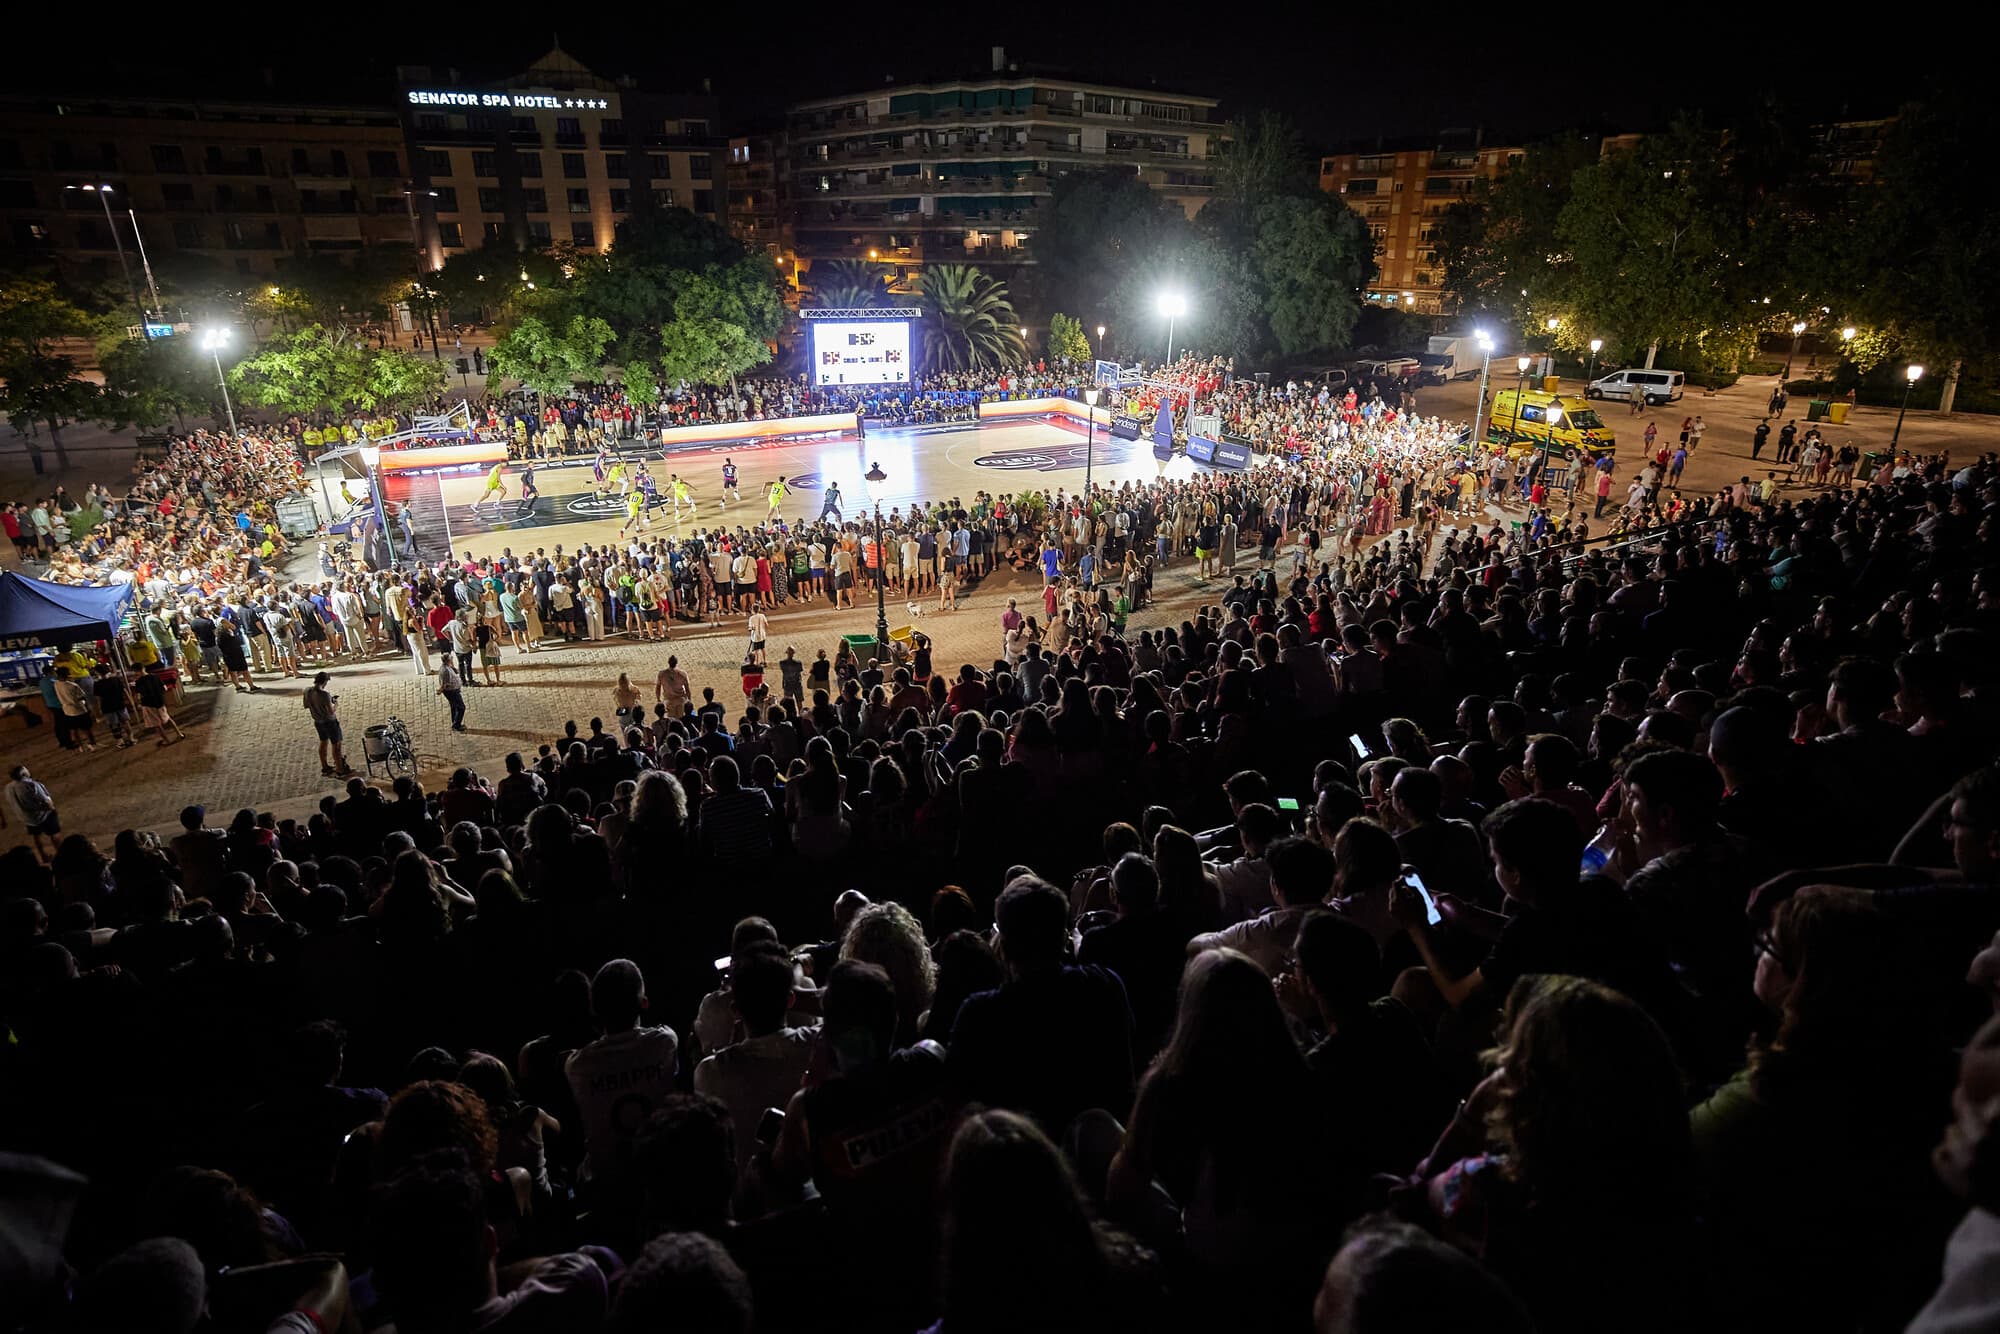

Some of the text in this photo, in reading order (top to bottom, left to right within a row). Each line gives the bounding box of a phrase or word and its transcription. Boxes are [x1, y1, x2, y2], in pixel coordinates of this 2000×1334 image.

[409, 91, 562, 109] SENATOR SPA HOTEL
[1115, 417, 1138, 431] endesa
[976, 456, 1047, 465] PULEVA
